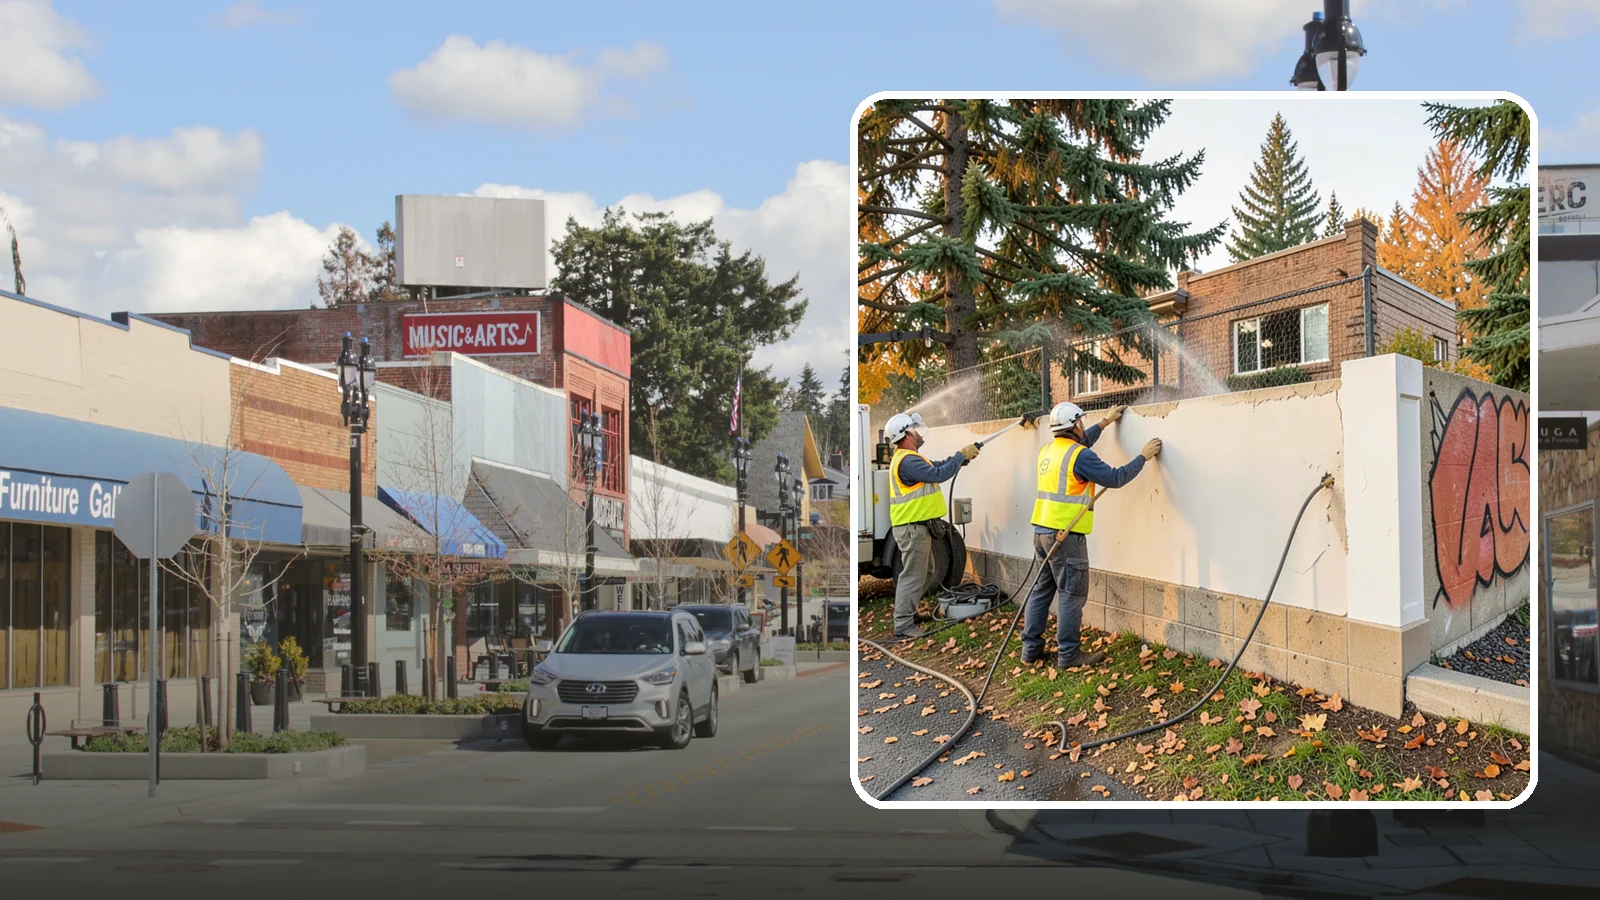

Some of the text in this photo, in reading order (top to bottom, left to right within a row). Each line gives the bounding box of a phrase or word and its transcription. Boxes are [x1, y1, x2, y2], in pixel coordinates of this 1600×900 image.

[409, 323, 519, 349] MUSIC&ARTS
[1540, 427, 1577, 437] UGA
[0, 471, 79, 515] Furniture
[453, 563, 479, 574] SUSHI
